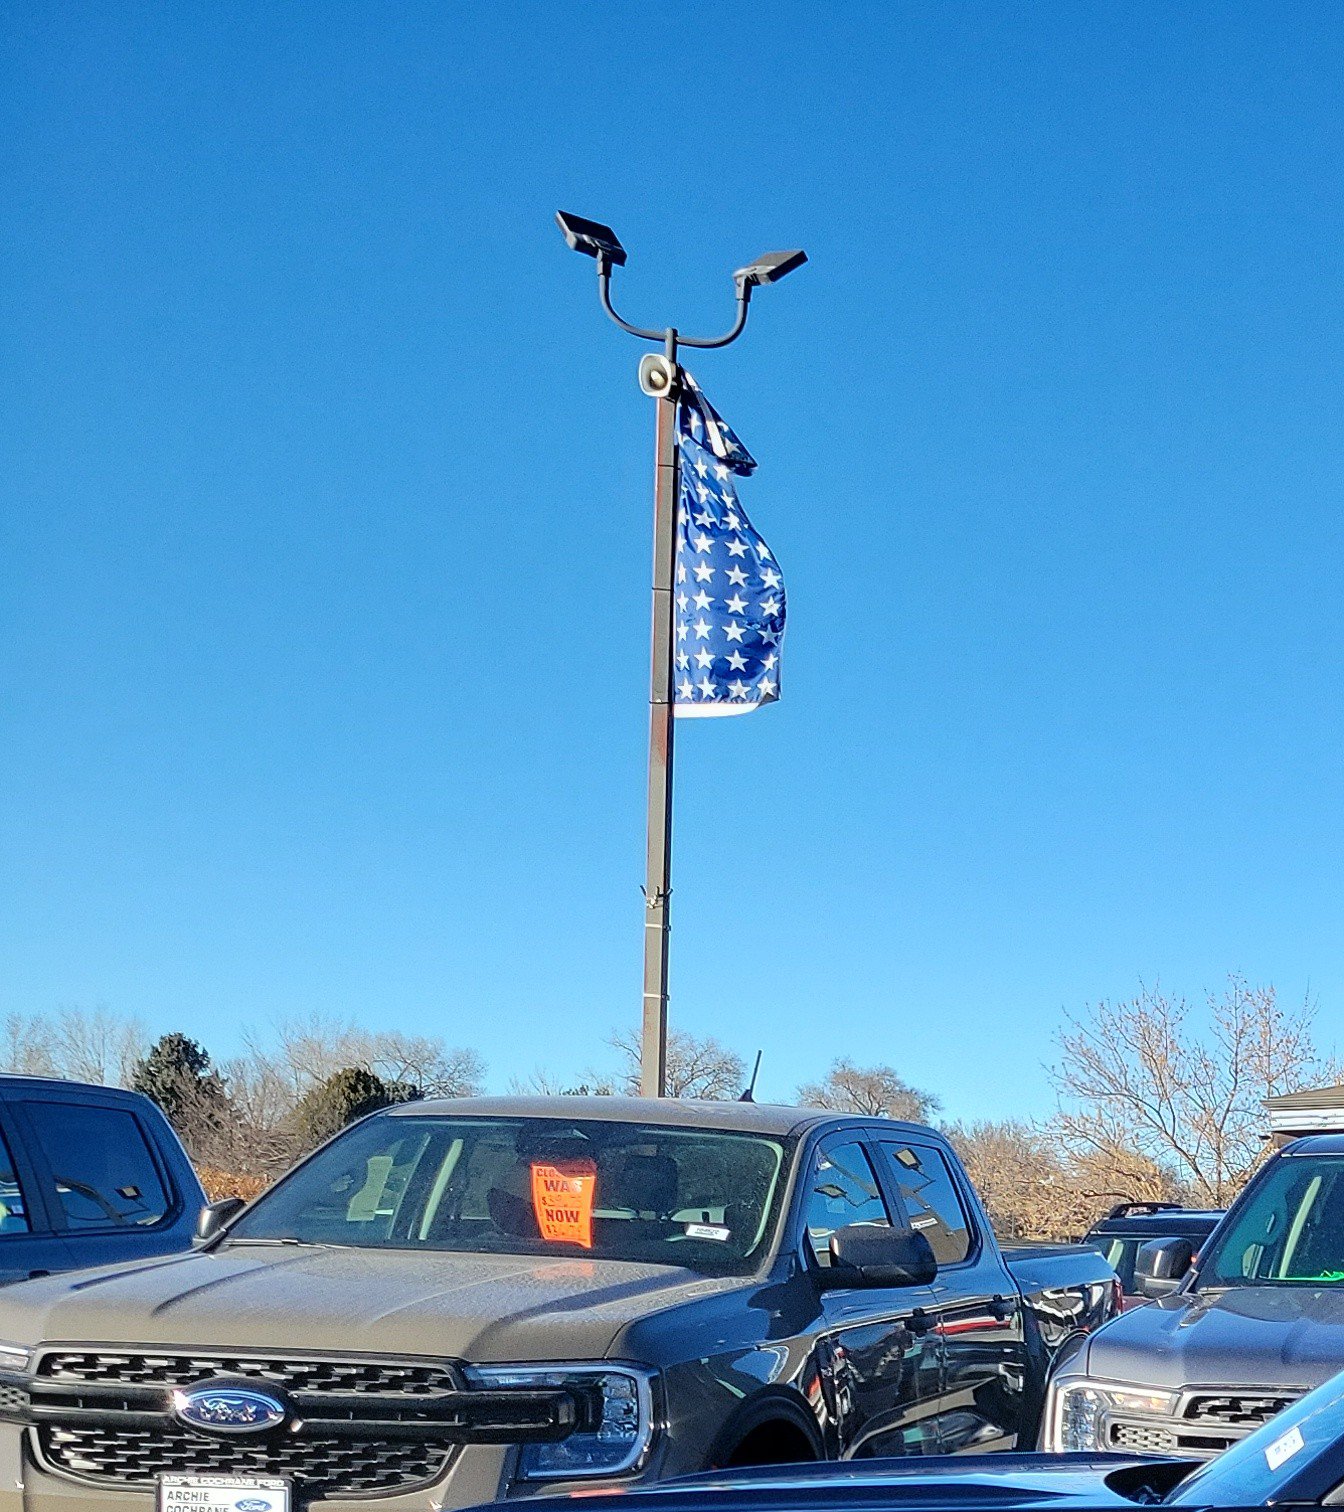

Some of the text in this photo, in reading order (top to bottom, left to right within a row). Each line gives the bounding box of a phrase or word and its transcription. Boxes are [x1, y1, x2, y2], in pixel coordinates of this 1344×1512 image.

[545, 1209, 580, 1223] NOW
[167, 1491, 209, 1502] ARCHIE
[239, 1499, 267, 1511] Ford
